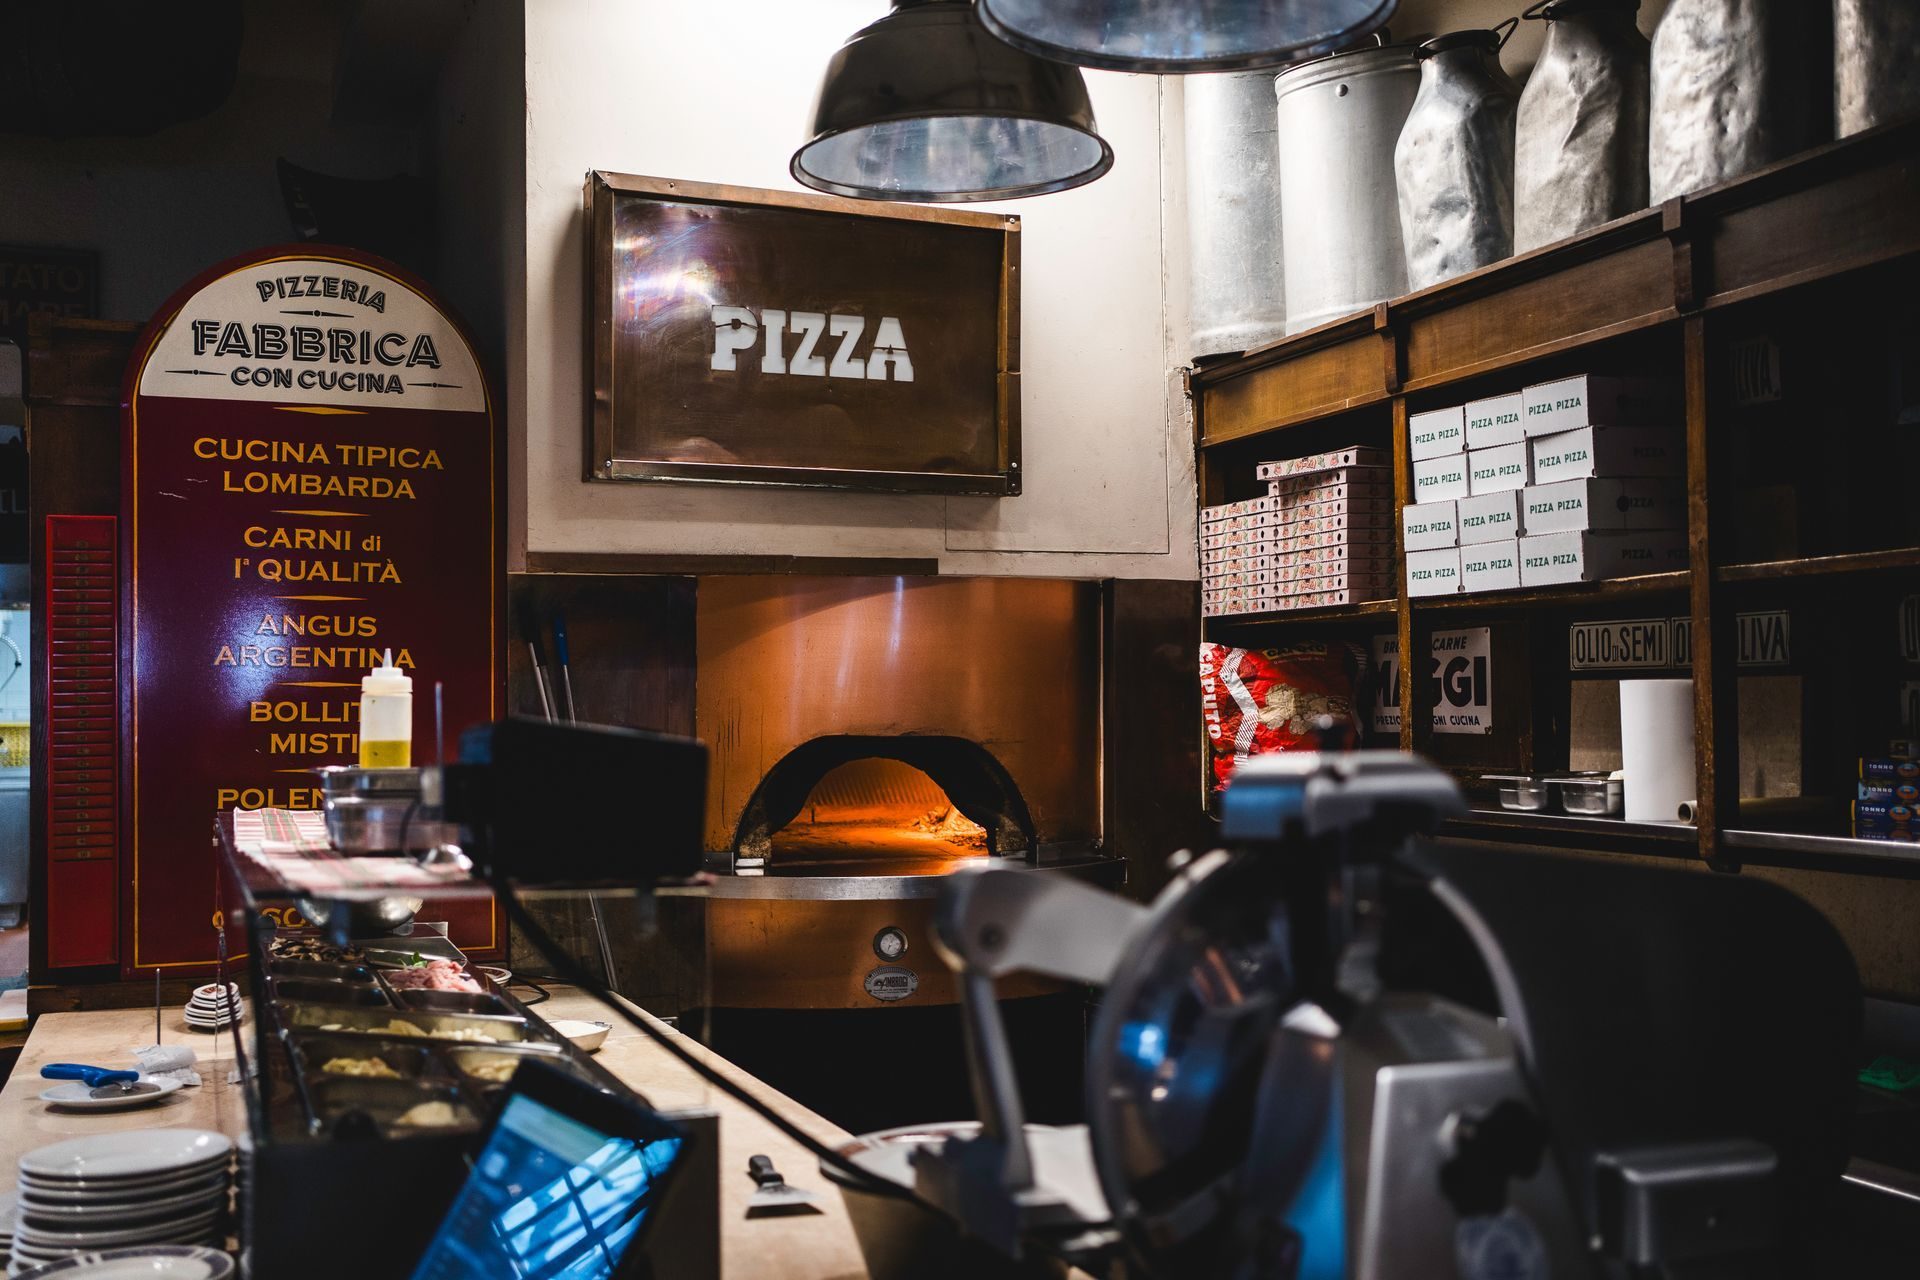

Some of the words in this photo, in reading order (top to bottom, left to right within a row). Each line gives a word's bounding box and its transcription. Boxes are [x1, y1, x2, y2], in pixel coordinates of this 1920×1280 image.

[256, 274, 386, 314] PIZZERIA
[192, 319, 442, 369] FABBRICA
[711, 304, 914, 382] PIZZA
[230, 366, 293, 389] CON
[297, 369, 405, 394] CUCINA
[1528, 403, 1553, 415] PIZZA
[1556, 398, 1582, 410] PIZZA
[1471, 418, 1493, 429] PIZZA
[1496, 413, 1519, 424] PIZZA
[1415, 433, 1436, 444] PIZZA
[1438, 428, 1460, 439] PIZZA
[193, 437, 331, 464] CUCINA
[336, 444, 444, 470] TIPICA
[1538, 456, 1562, 468] PIZZA
[1564, 451, 1588, 462] PIZZA
[1418, 477, 1439, 486] PIZZA
[1441, 473, 1462, 483] PIZZA
[1474, 469, 1496, 480] PIZZA
[1498, 464, 1522, 475] PIZZA
[223, 470, 416, 499] LOMBARDA
[1529, 503, 1554, 514] PIZZA
[1557, 499, 1583, 510] PIZZA
[1630, 497, 1655, 508] IZZA
[1407, 525, 1428, 534] PIZZA
[1430, 522, 1452, 531] PIZZA
[1463, 516, 1486, 527] PIZZA
[1488, 512, 1512, 523] PIZZA
[244, 526, 351, 550] CARNI
[362, 535, 381, 551] di
[1465, 562, 1488, 572] PIZZA
[1490, 559, 1513, 569] PIZZA
[1525, 557, 1550, 568] PIZZA
[1552, 554, 1578, 565] PIZZA
[258, 558, 402, 583] QUALITÀ
[1411, 571, 1433, 579] PIZZA
[1435, 568, 1456, 577] PIZZA
[257, 614, 377, 637] ANGUS
[1433, 636, 1468, 651] CARNE
[1576, 627, 1611, 664] OLIO
[1619, 624, 1663, 663] SEMI
[1740, 615, 1788, 662] LIVA
[214, 645, 416, 671] ARGENTINA
[1374, 655, 1487, 708] MGI
[1199, 649, 1222, 739] CAPUTO
[1450, 714, 1481, 726] CUCINA
